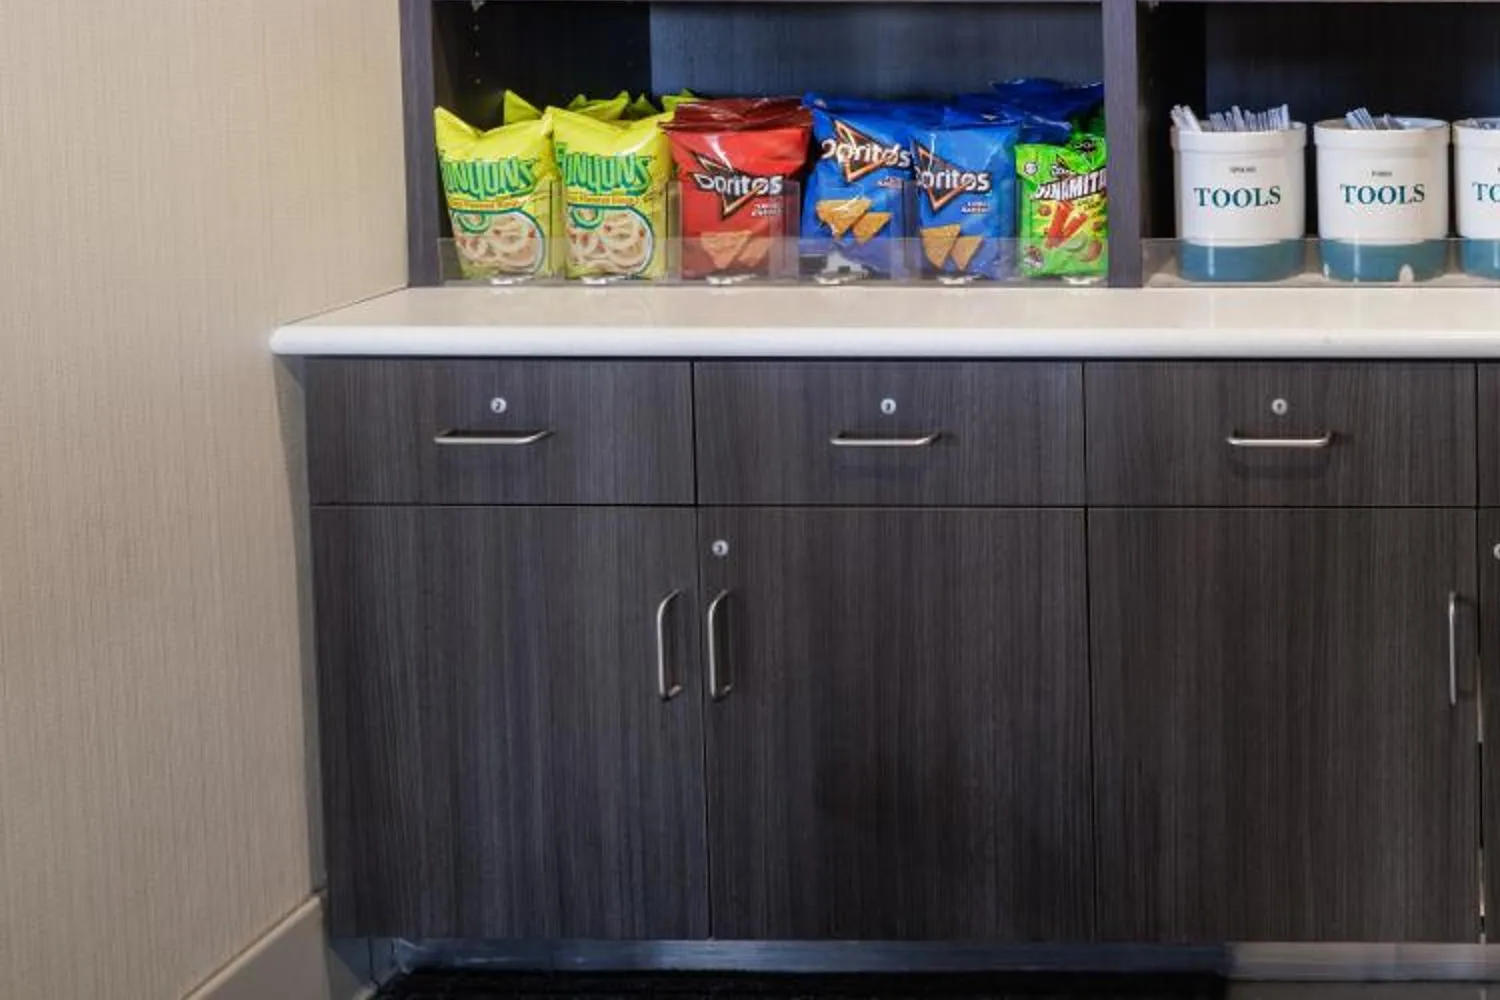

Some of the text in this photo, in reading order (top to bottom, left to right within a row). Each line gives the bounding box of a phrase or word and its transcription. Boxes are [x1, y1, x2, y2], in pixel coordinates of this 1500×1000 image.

[694, 173, 783, 195] Doritos
[1340, 183, 1426, 206] TOOLS
[1193, 185, 1282, 209] TOOLS
